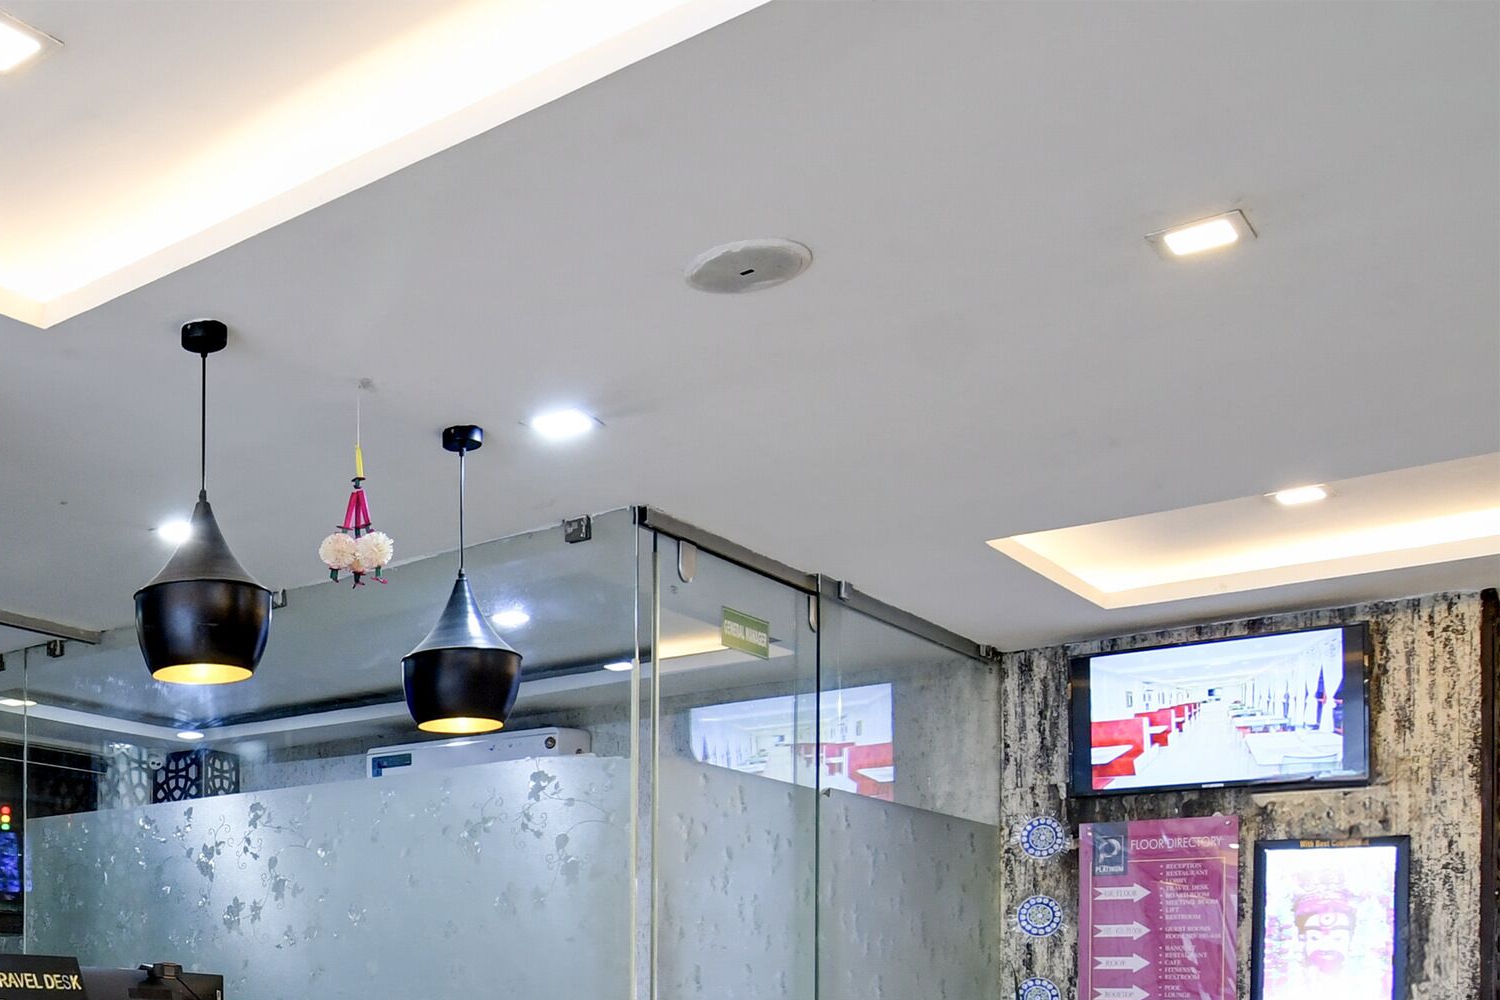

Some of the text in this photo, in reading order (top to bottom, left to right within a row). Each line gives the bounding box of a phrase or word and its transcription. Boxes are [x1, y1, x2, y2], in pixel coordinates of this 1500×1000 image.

[723, 619, 768, 648] GENERAL MANAGER
[1130, 836, 1223, 850] FLOOR DIRECTORY
[1094, 865, 1124, 873] PLATINUM
[43, 973, 83, 991] DESK
